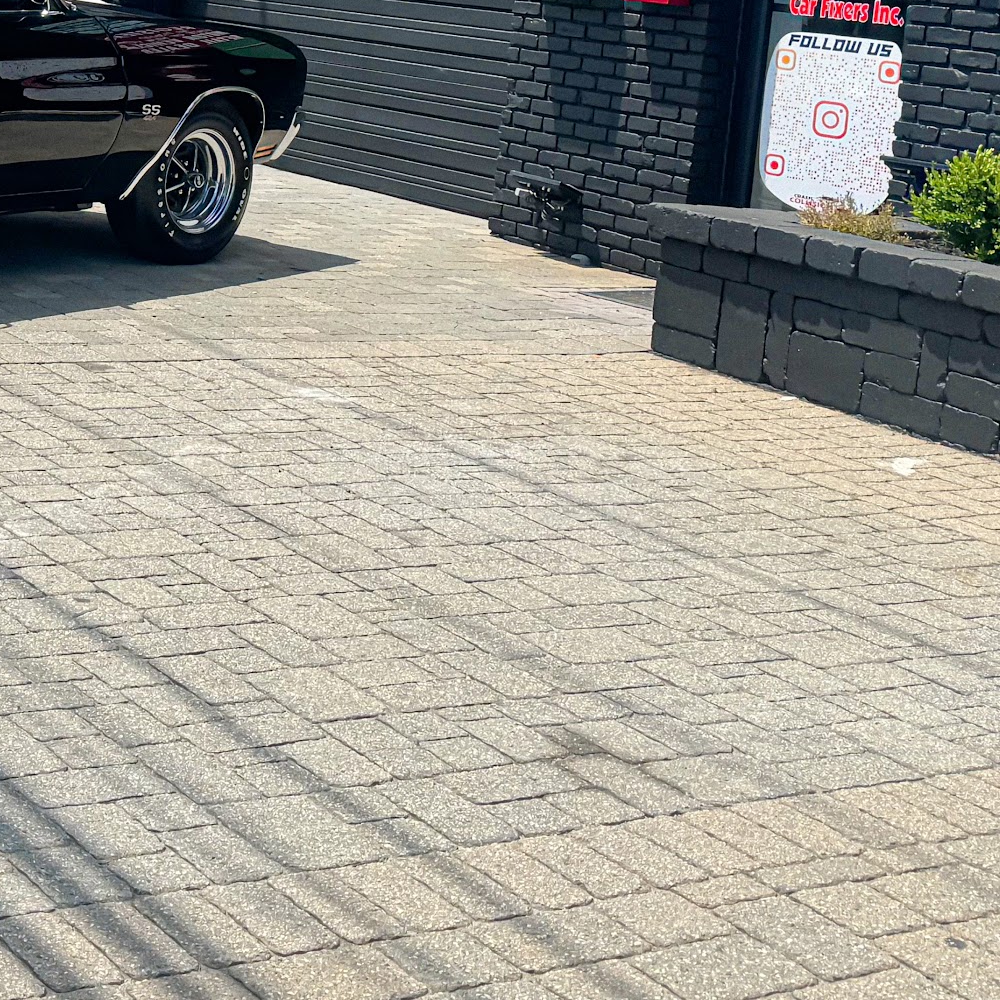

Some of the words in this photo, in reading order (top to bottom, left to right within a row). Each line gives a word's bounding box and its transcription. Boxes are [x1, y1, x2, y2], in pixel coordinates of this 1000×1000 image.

[872, 0, 905, 27] Inc.
[788, 34, 862, 53] FOLLOW
[867, 42, 894, 57] US
[142, 104, 161, 115] SS
